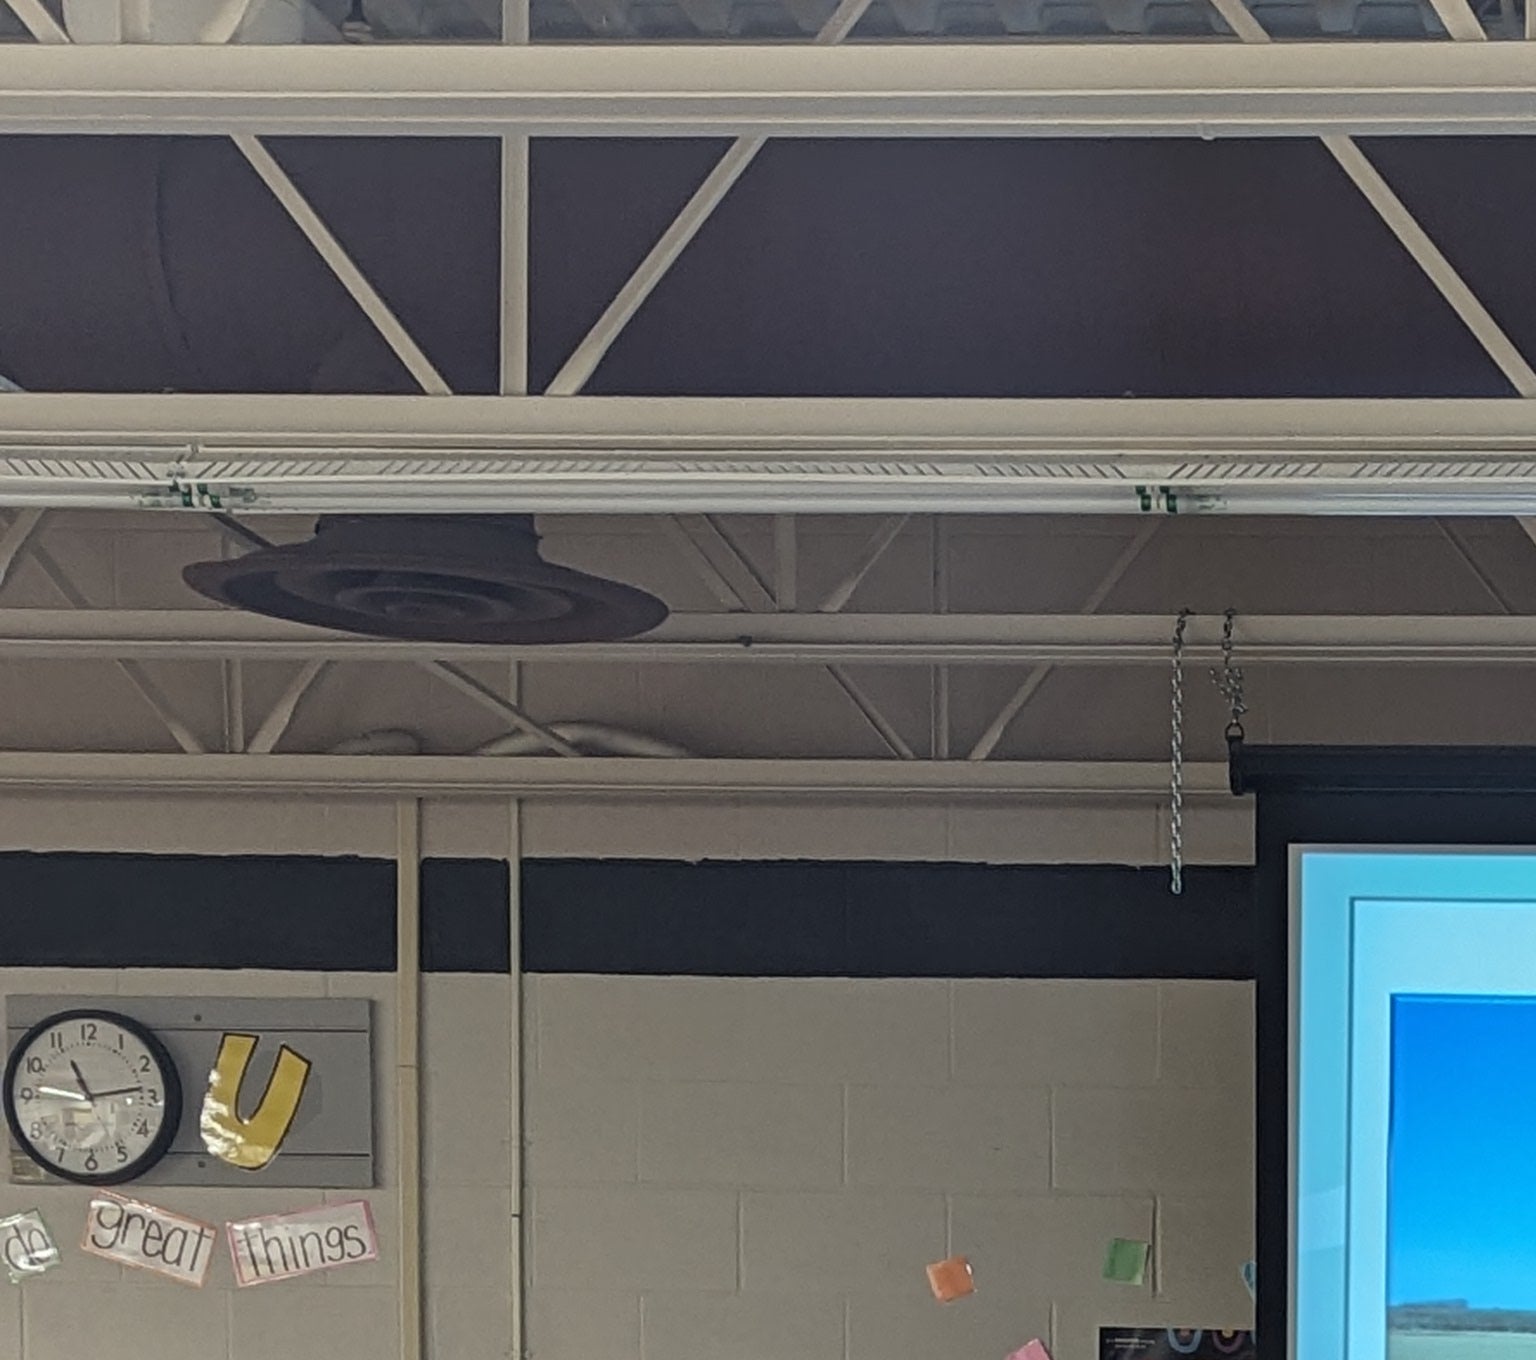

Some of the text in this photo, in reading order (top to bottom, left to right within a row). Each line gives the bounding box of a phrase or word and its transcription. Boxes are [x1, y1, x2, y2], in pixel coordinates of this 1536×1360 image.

[51, 1032, 62, 1048] 11
[81, 1023, 97, 1040] 12
[119, 1034, 124, 1050] 1
[27, 1057, 43, 1073] 10
[140, 1055, 150, 1073] 2
[21, 1087, 33, 1104] 9
[148, 1089, 159, 1107] 3
[201, 1032, 312, 1170] U
[30, 1122, 42, 1140] 8
[136, 1119, 149, 1137] 4
[55, 1148, 66, 1163] 7
[85, 1150, 98, 1171] 6
[117, 1146, 128, 1162] 5
[5, 1200, 367, 1277] do great things
